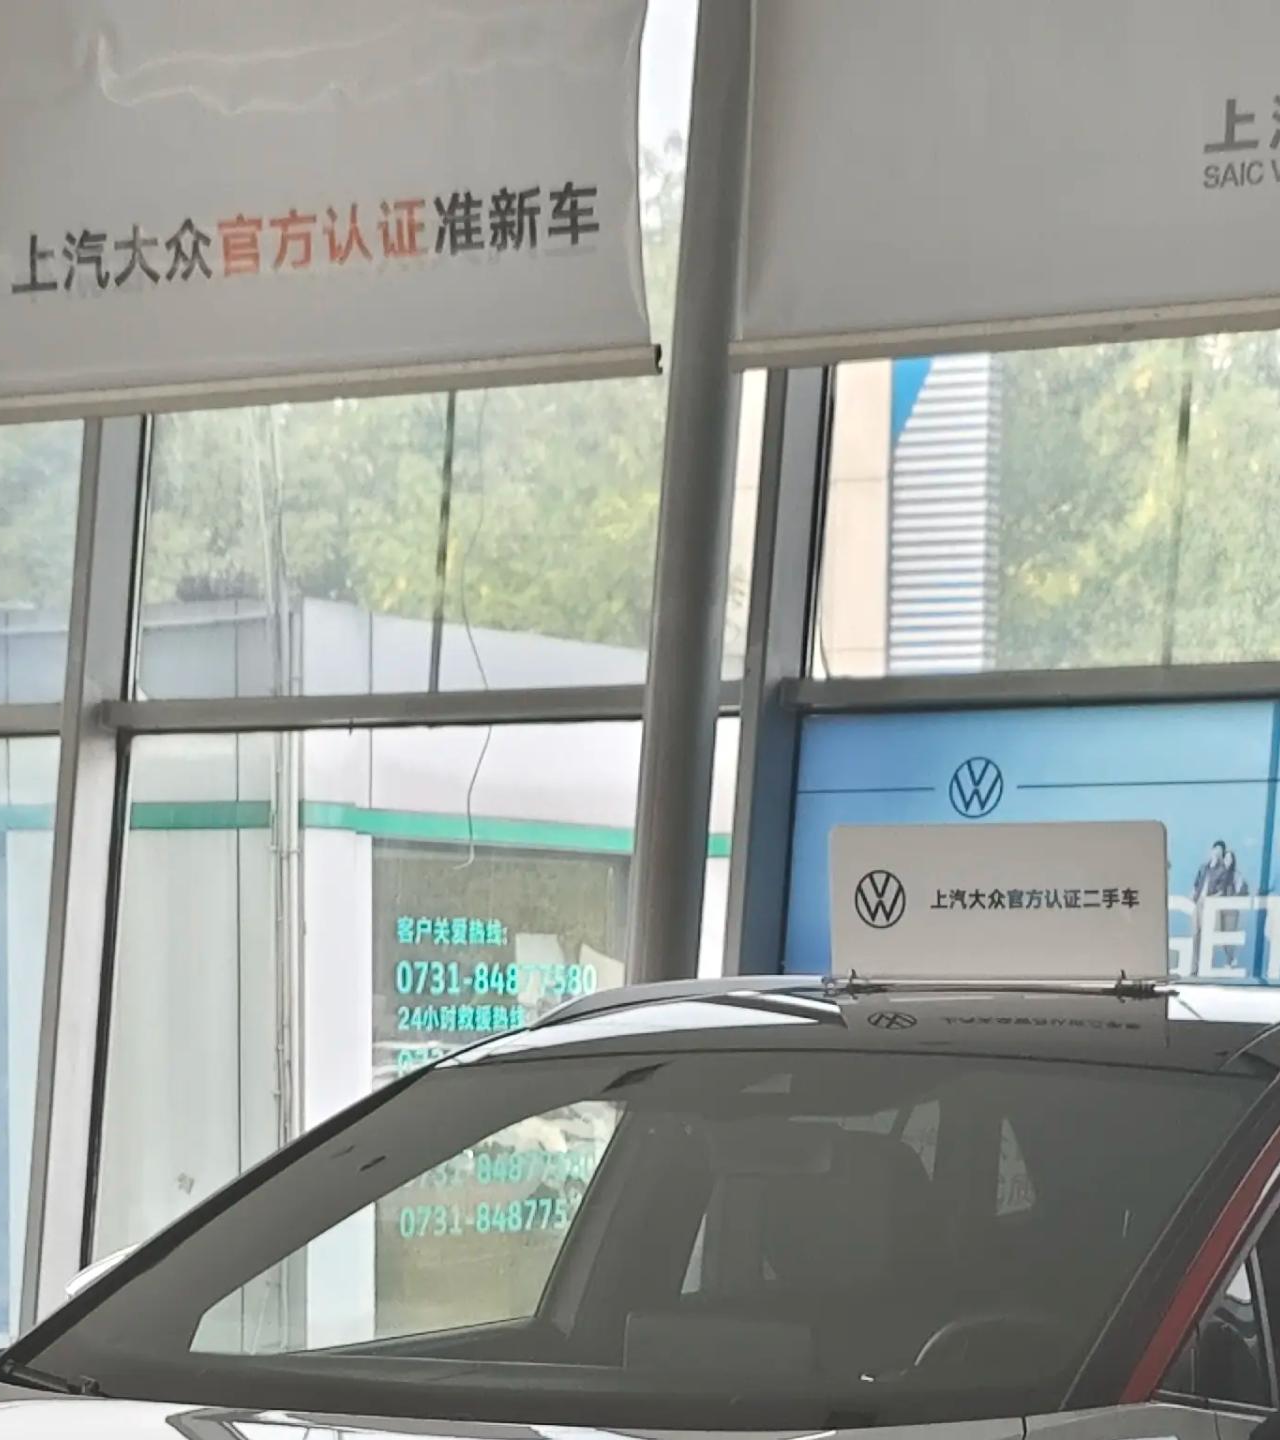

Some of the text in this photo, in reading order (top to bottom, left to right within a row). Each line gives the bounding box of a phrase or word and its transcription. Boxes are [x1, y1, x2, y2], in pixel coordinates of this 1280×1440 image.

[1203, 160, 1265, 189] SAIC
[11, 181, 600, 294] 上汽大众官方认证准新车
[930, 887, 1140, 911] 上汽大众官方认证二手车
